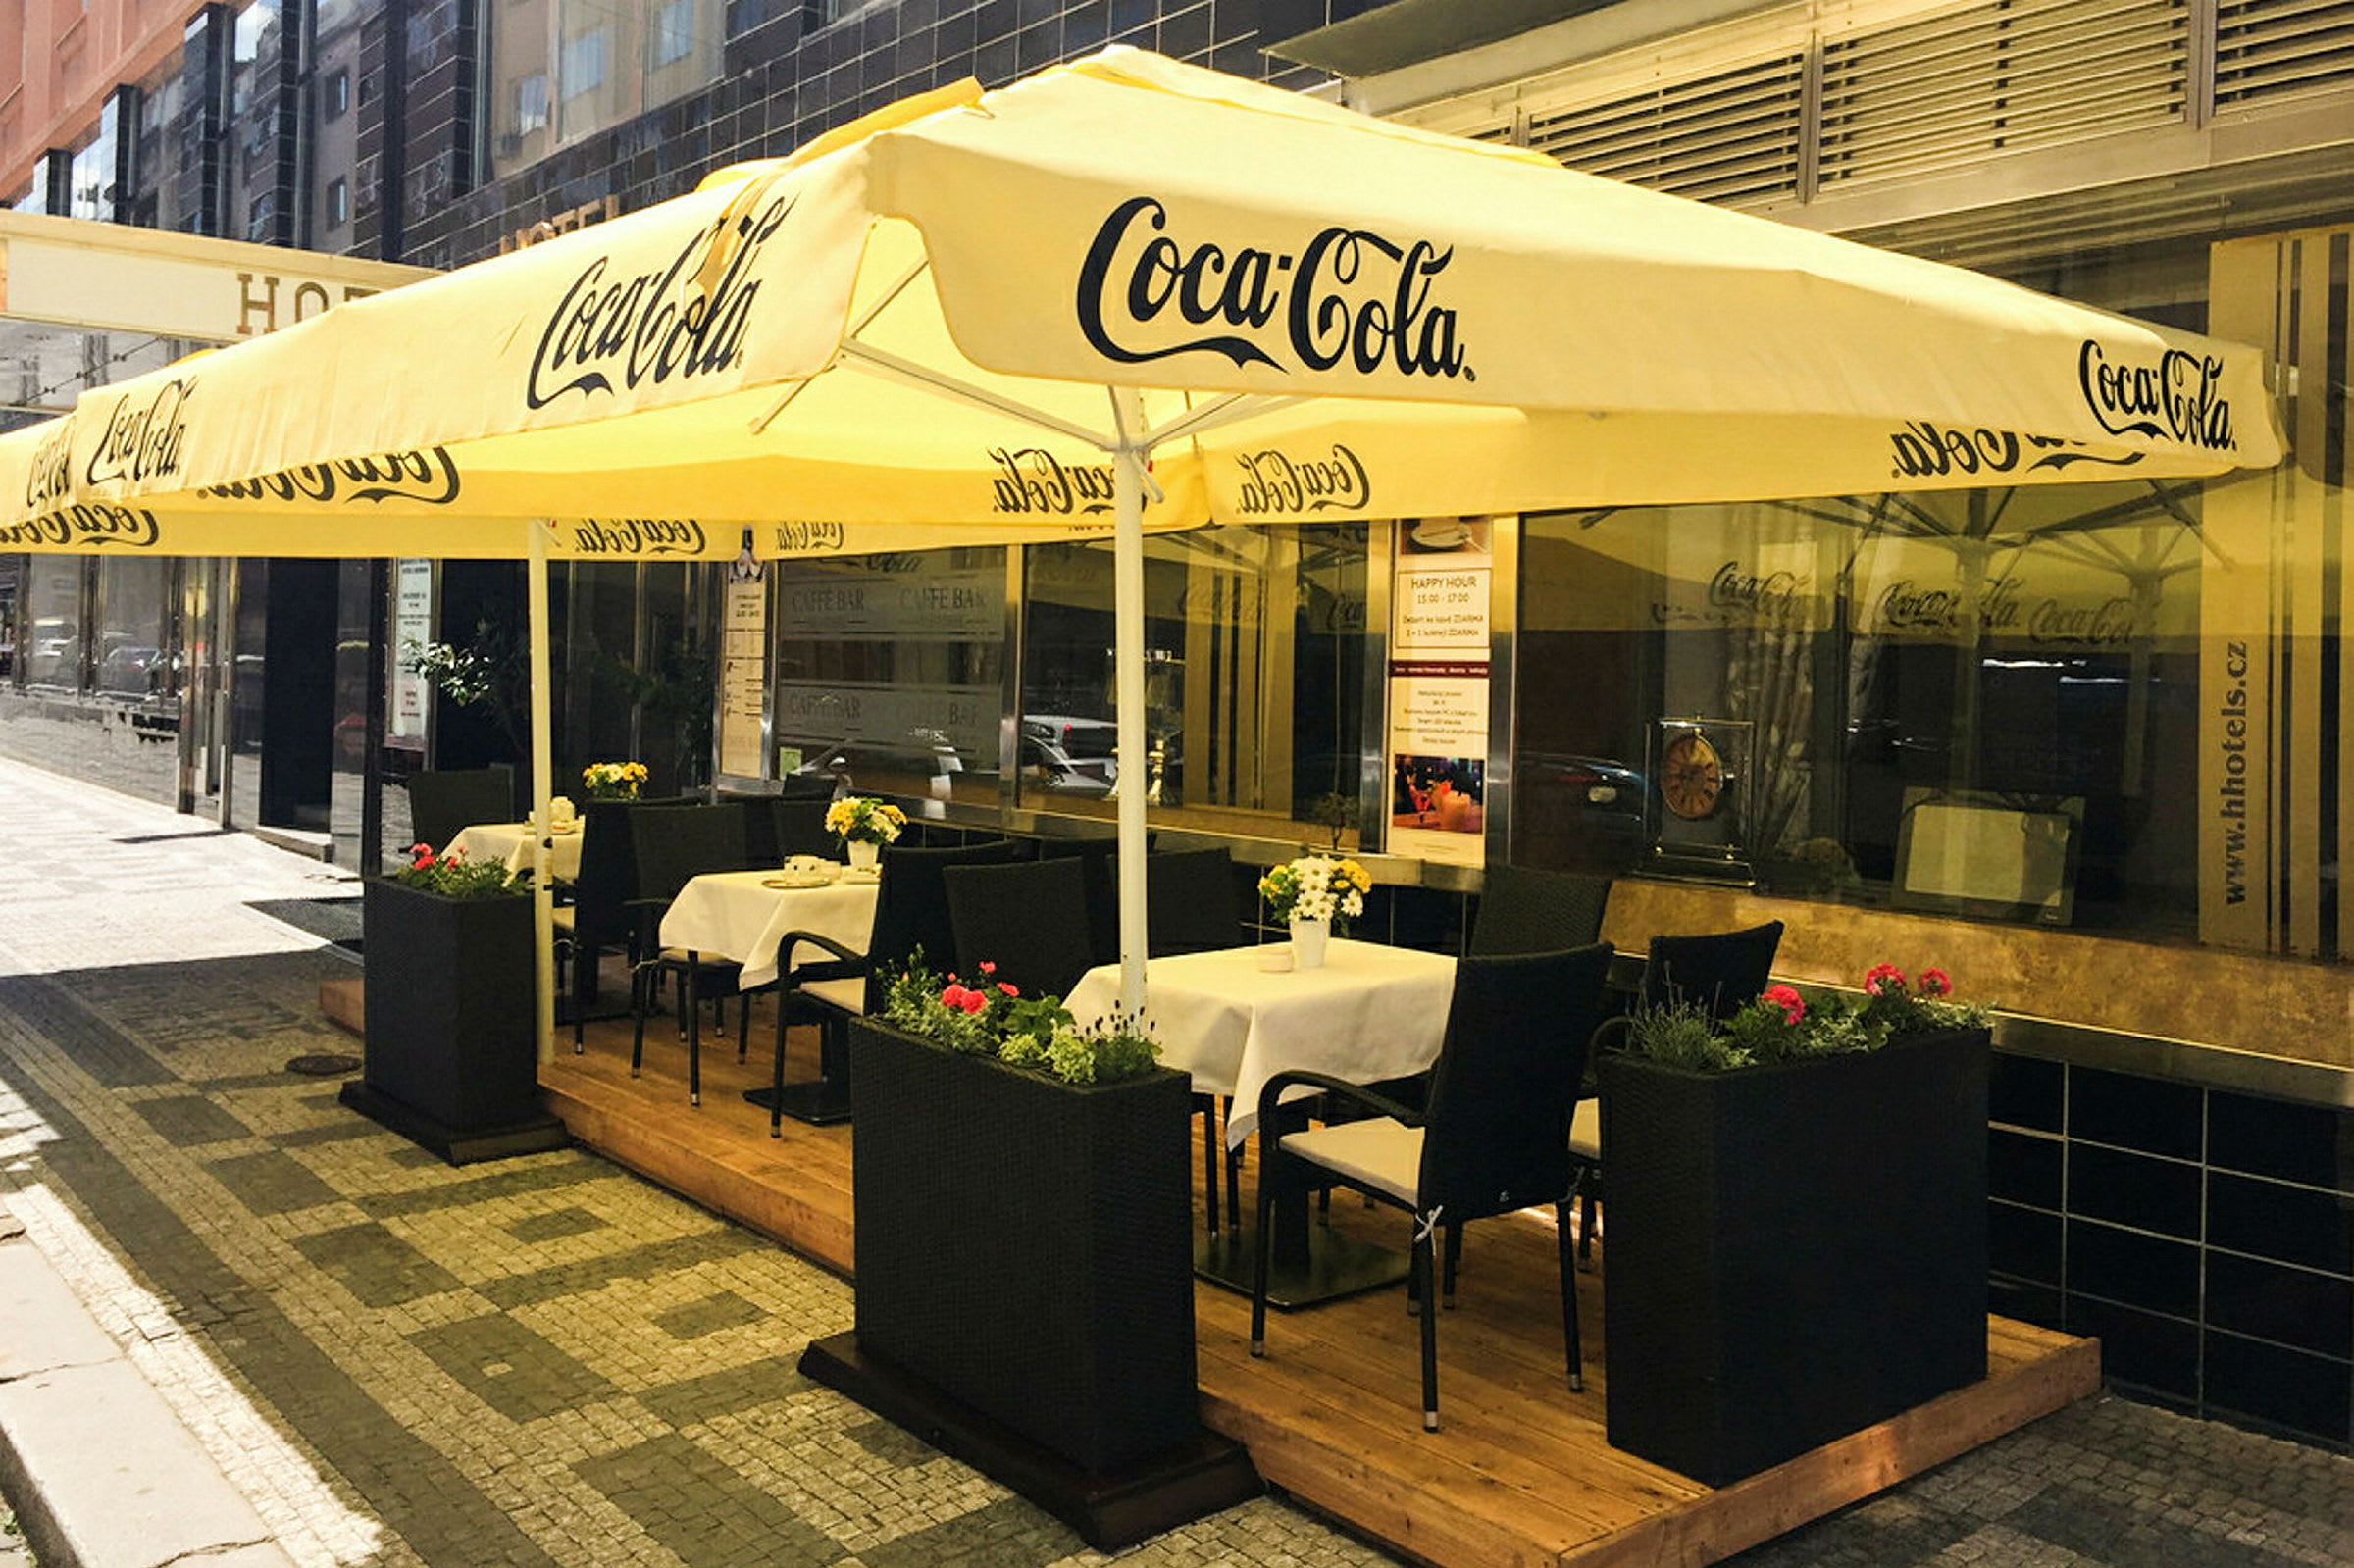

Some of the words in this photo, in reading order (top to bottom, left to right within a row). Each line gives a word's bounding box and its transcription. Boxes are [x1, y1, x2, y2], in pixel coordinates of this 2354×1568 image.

[237, 273, 381, 334] HO
[527, 192, 800, 410] Coca-Cola
[1077, 196, 1475, 381] Coca-Cola
[2078, 339, 2236, 451] Coca-Cola
[1411, 577, 1444, 589] HAPPY
[1446, 576, 1477, 588] HOUR
[2220, 640, 2247, 905] www.hhotels.cz
